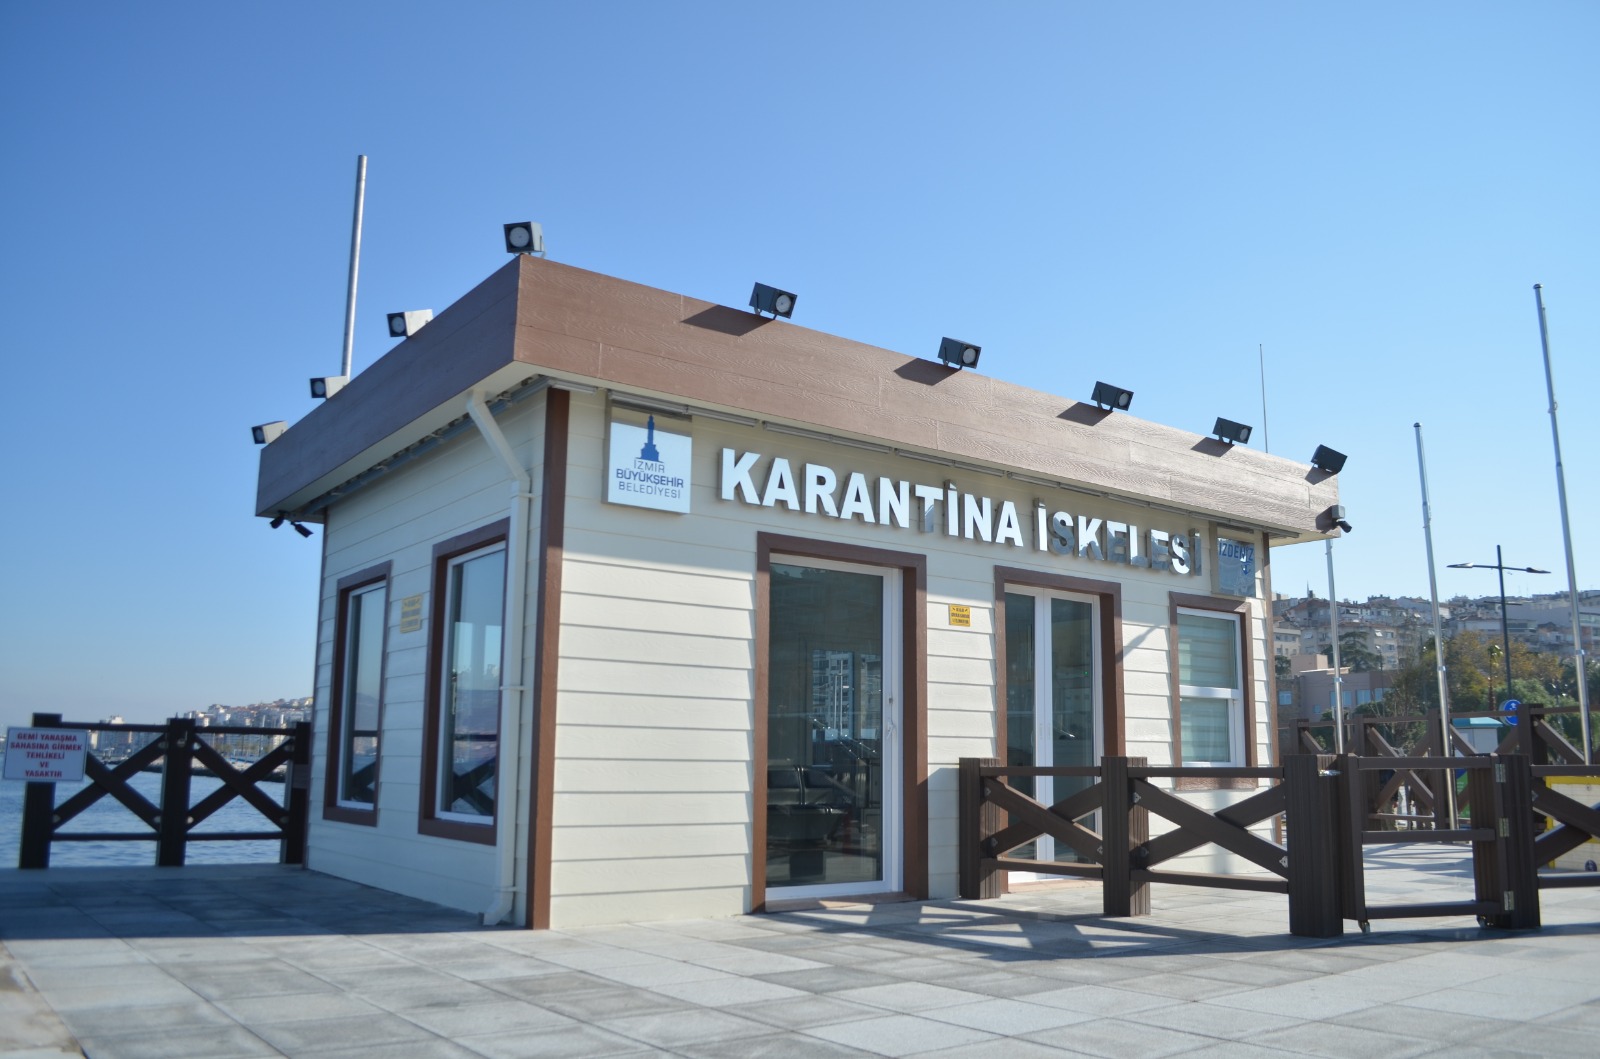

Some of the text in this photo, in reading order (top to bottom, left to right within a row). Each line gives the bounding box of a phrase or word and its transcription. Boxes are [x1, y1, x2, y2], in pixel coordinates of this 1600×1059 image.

[616, 468, 684, 488] BÜYÜKŞEHİR
[618, 481, 681, 499] BELEDİYESİ
[721, 447, 1203, 577] KARANTİNA İSKELESİ
[17, 732, 77, 742] GEMİ YANAŞMA
[10, 742, 82, 751] SAHASINA GİRMEK
[26, 751, 65, 759] TEHLİKELİ
[25, 770, 63, 778] YASAKTIR
